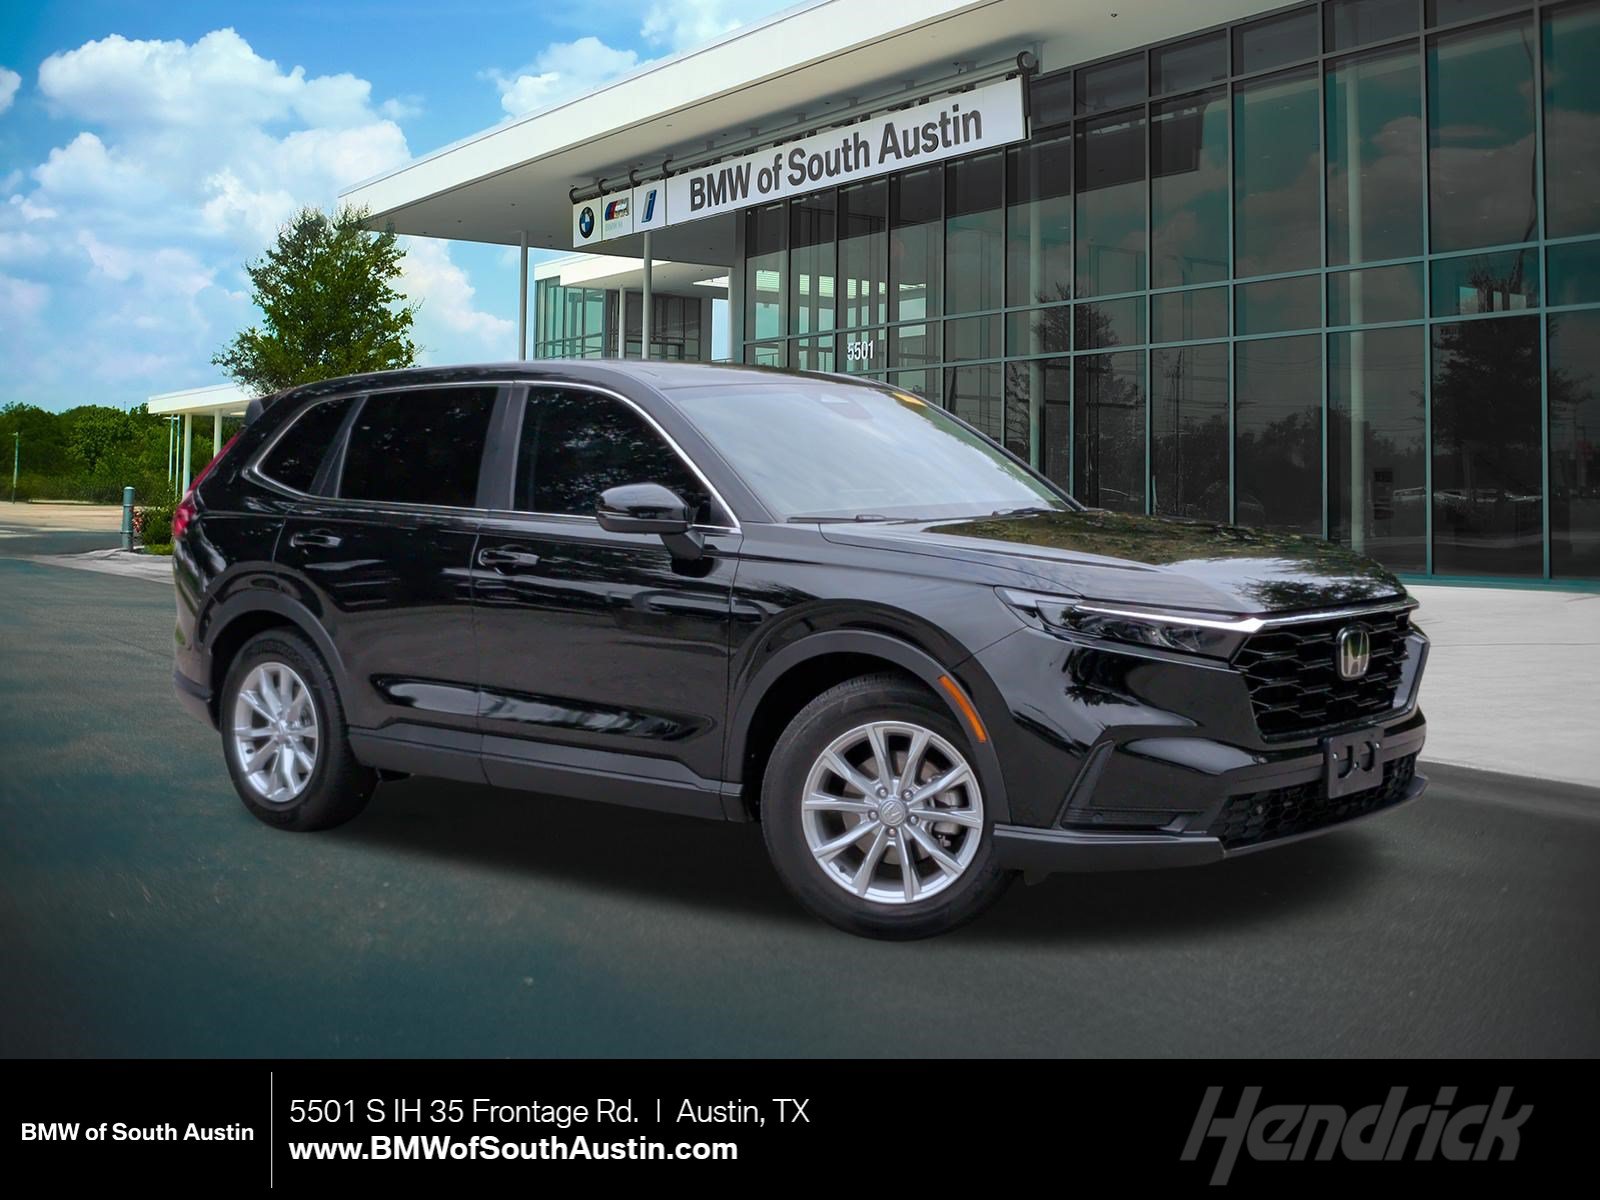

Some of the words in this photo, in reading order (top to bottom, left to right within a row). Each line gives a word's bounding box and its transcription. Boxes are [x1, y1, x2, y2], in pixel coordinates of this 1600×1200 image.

[690, 162, 752, 212] BMW
[756, 153, 783, 194] of
[787, 132, 871, 187] South
[878, 104, 983, 165] Austin
[847, 340, 874, 361] 5501
